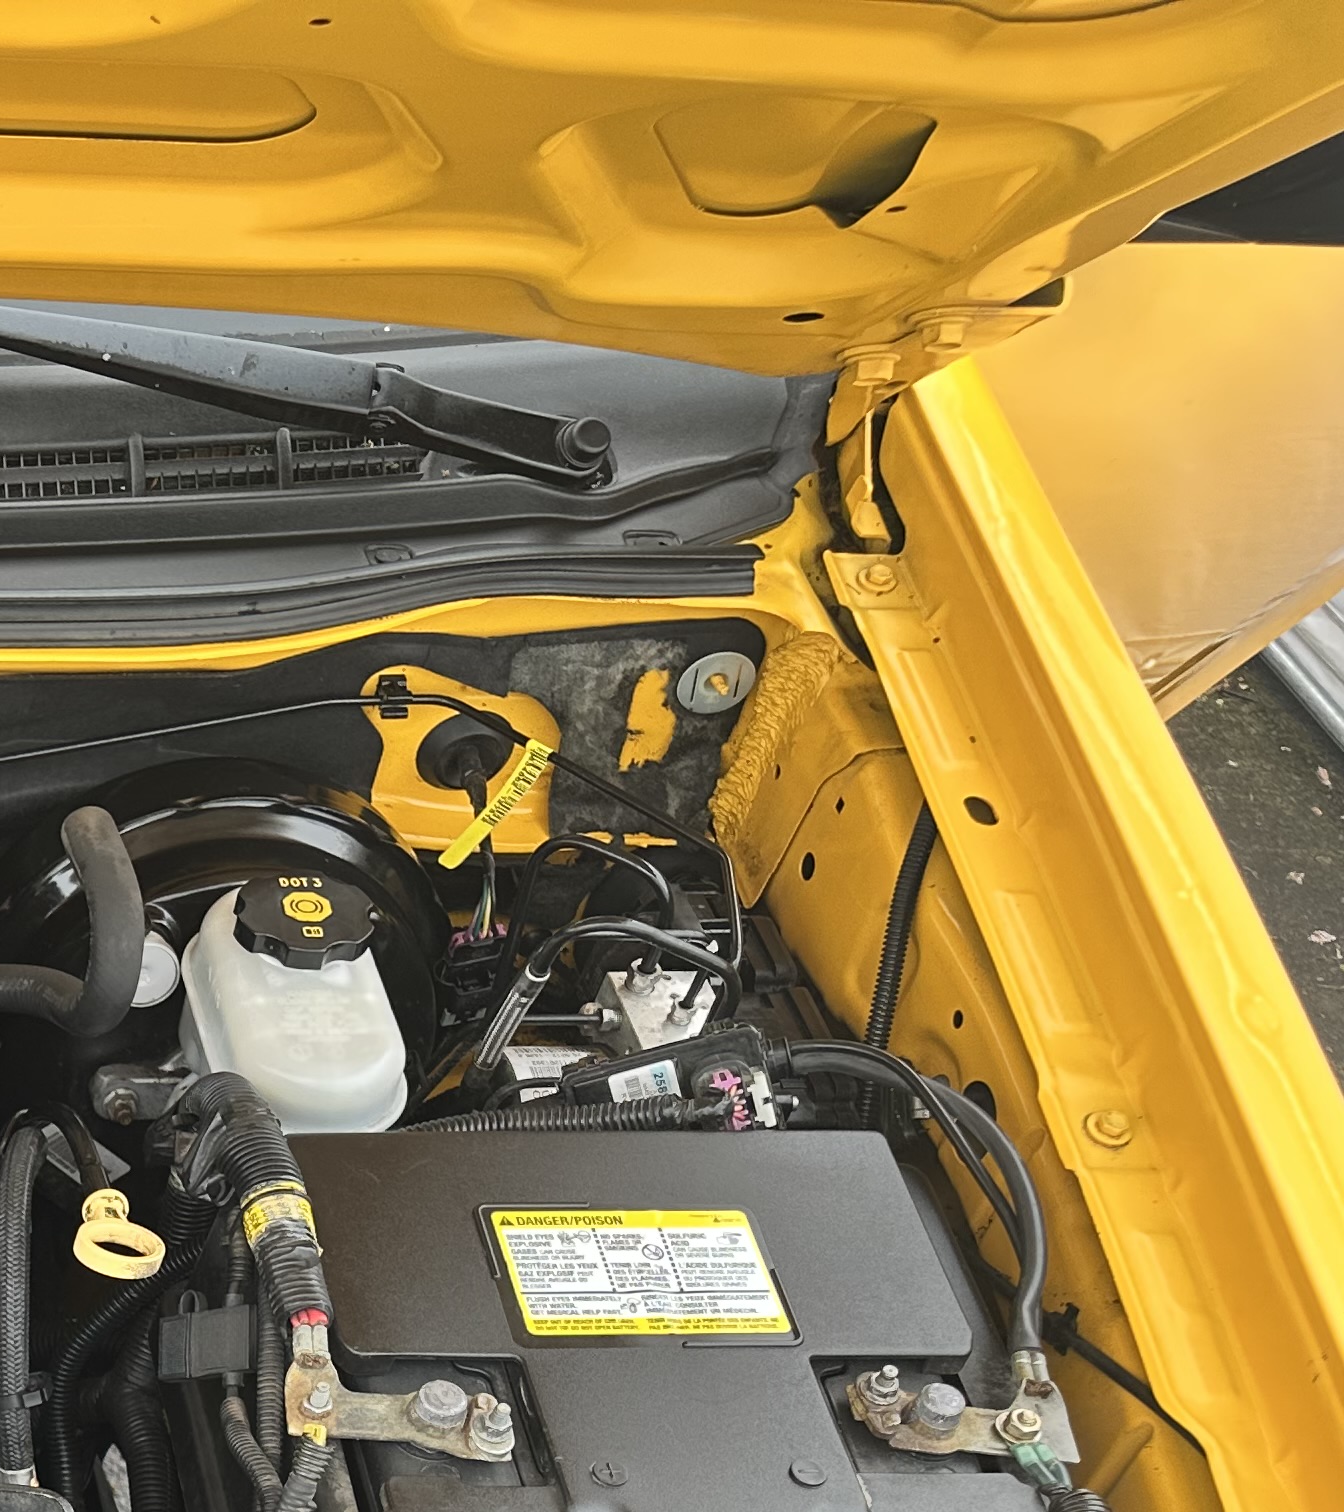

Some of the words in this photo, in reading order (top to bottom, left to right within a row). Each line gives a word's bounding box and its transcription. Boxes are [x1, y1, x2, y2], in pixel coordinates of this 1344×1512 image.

[278, 877, 308, 888] DOT
[312, 877, 322, 888] 3
[516, 1215, 623, 1226] DANGER/POISON
